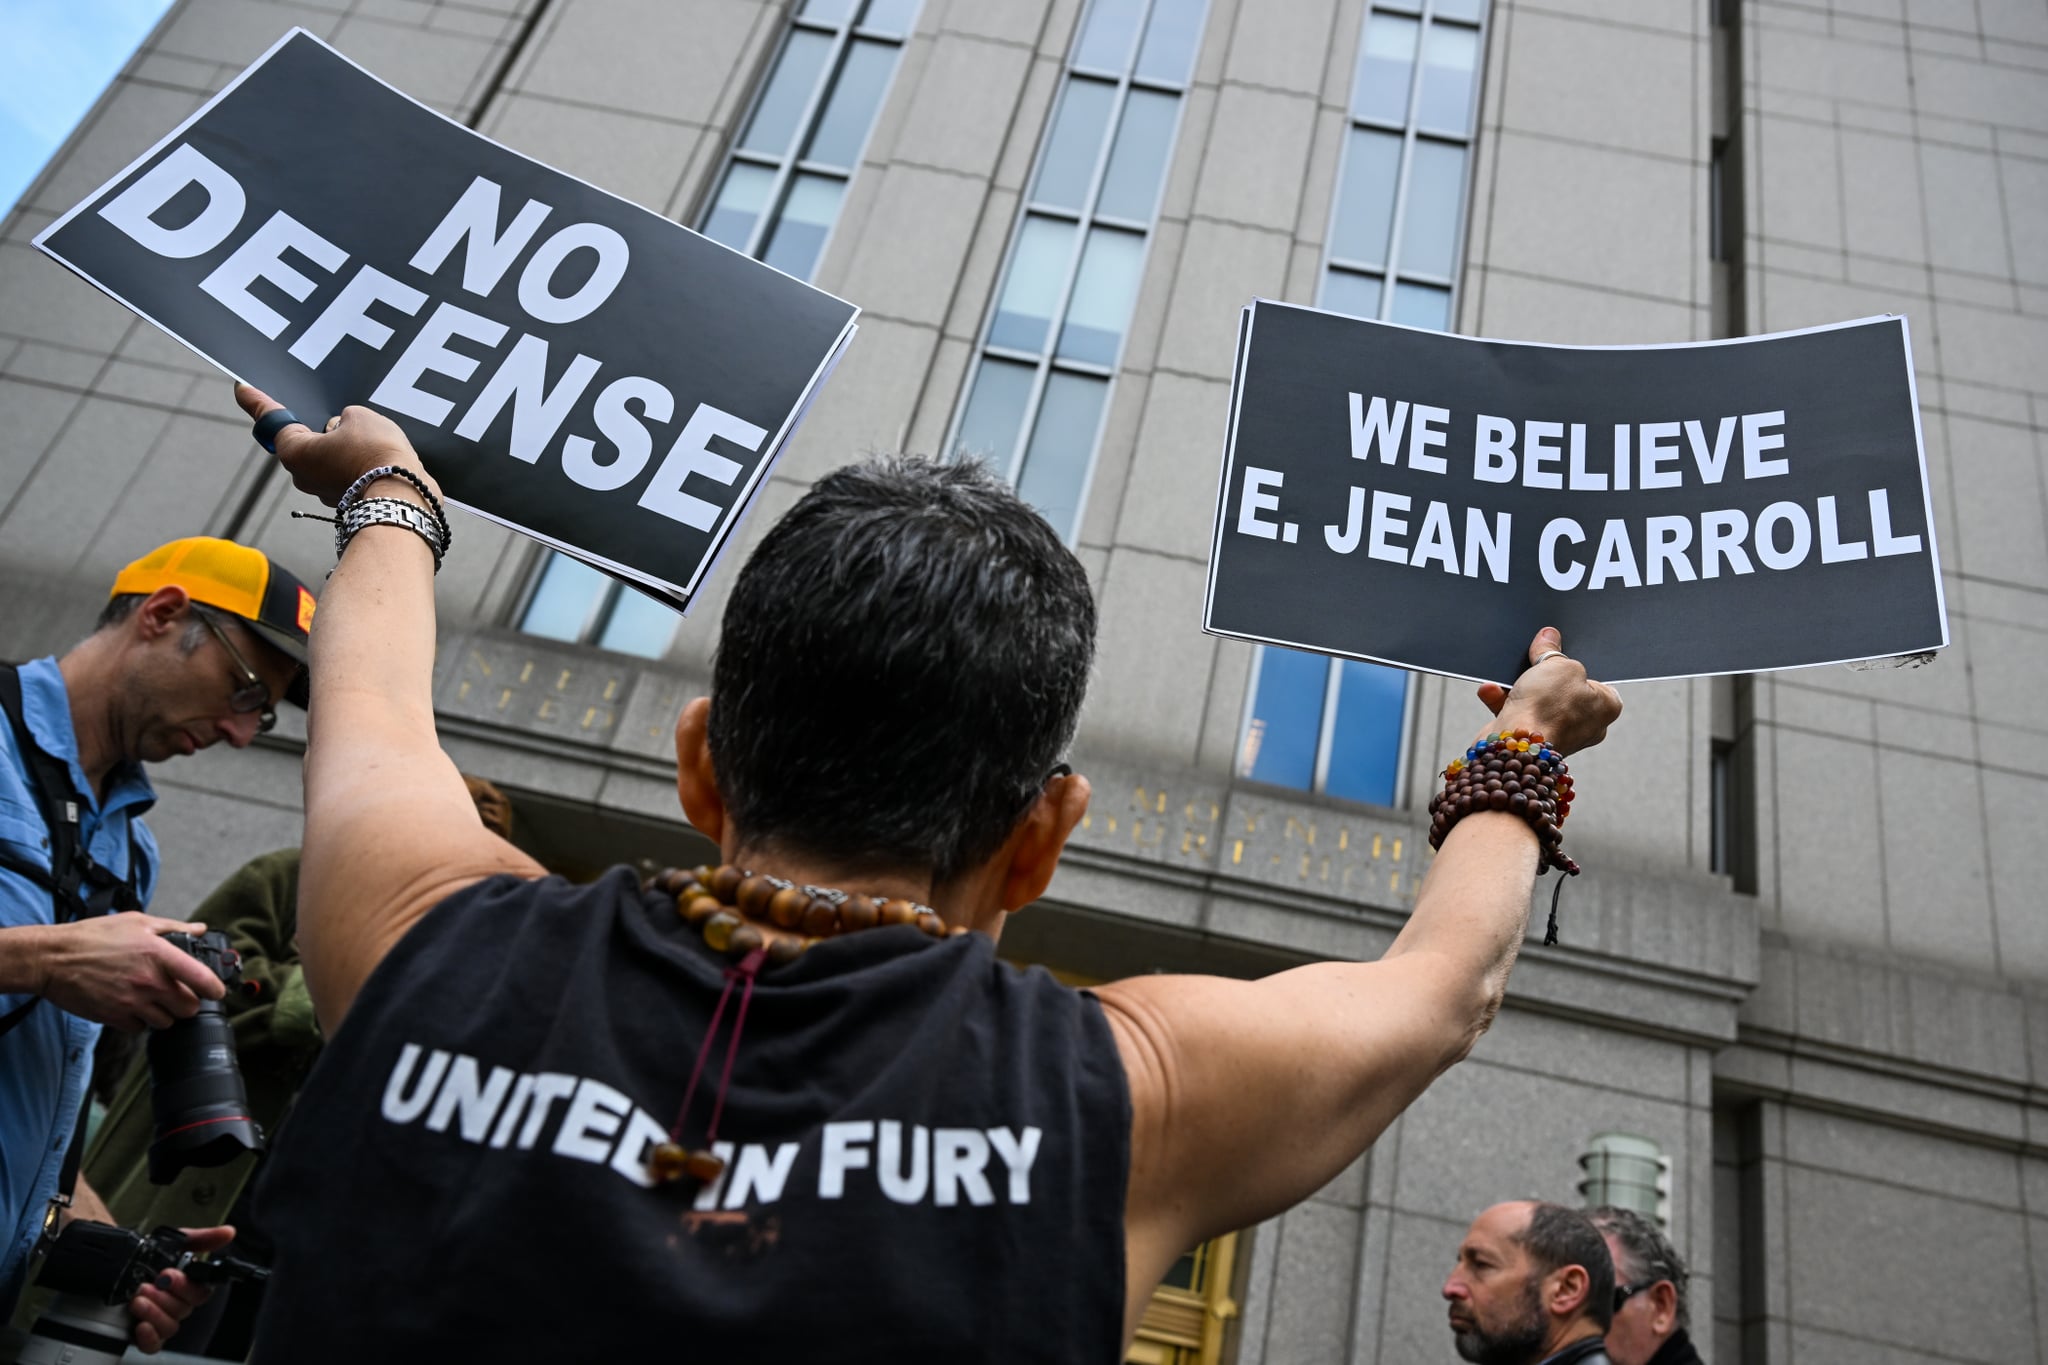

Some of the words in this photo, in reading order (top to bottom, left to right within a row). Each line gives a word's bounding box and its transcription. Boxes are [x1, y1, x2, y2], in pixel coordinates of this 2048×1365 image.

[409, 176, 630, 324] NO
[97, 143, 768, 533] DEFENSE
[1349, 392, 1450, 474] WE
[1474, 411, 1789, 490] BELIEVE
[1237, 466, 1298, 543] E.
[1324, 486, 1512, 584] JEAN
[1539, 488, 1922, 591] CARROLL
[1081, 812, 1252, 866] OURT
[381, 1043, 669, 1187] UNITED
[692, 1141, 800, 1211] IN
[818, 1119, 1042, 1207] FURY
